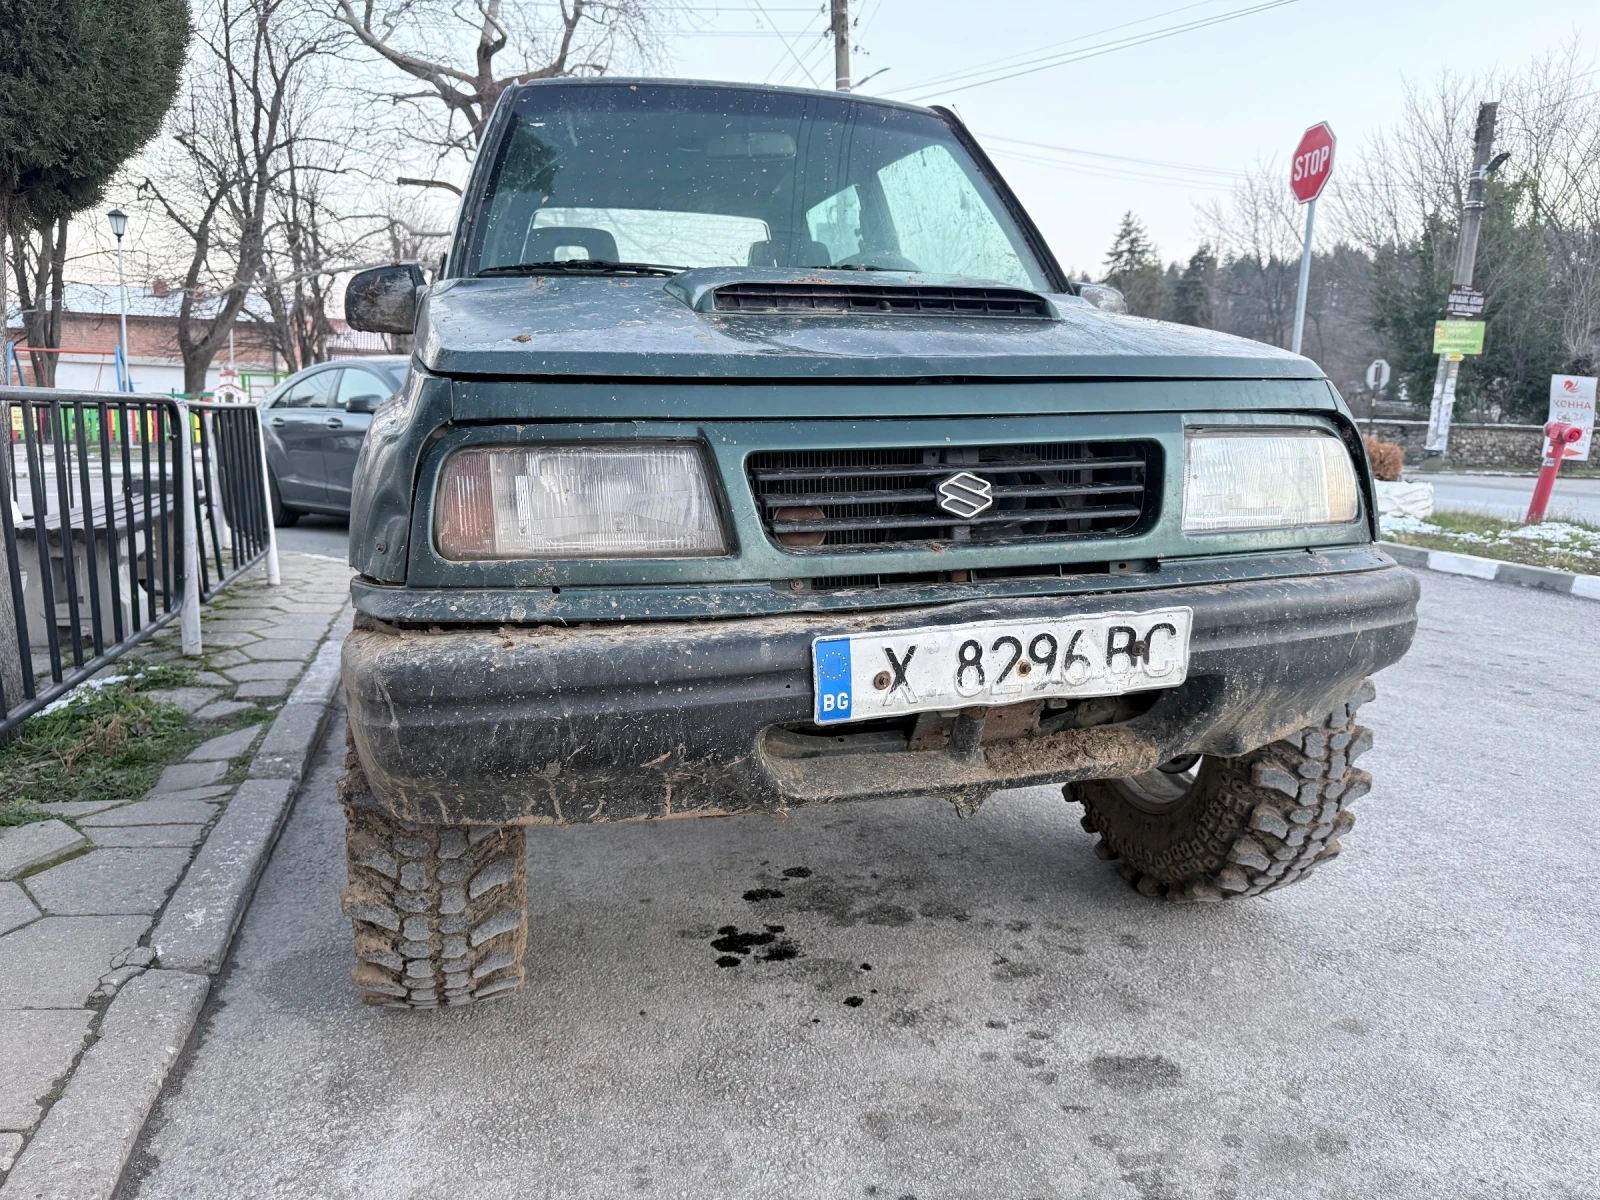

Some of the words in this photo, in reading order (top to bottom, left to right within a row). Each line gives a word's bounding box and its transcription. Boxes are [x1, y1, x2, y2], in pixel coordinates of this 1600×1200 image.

[1294, 145, 1330, 182] STOP
[1553, 399, 1592, 409] КОННА
[882, 645, 919, 706] X
[953, 629, 1092, 699] 8296
[1105, 623, 1177, 684] BC
[822, 693, 849, 712] BG
